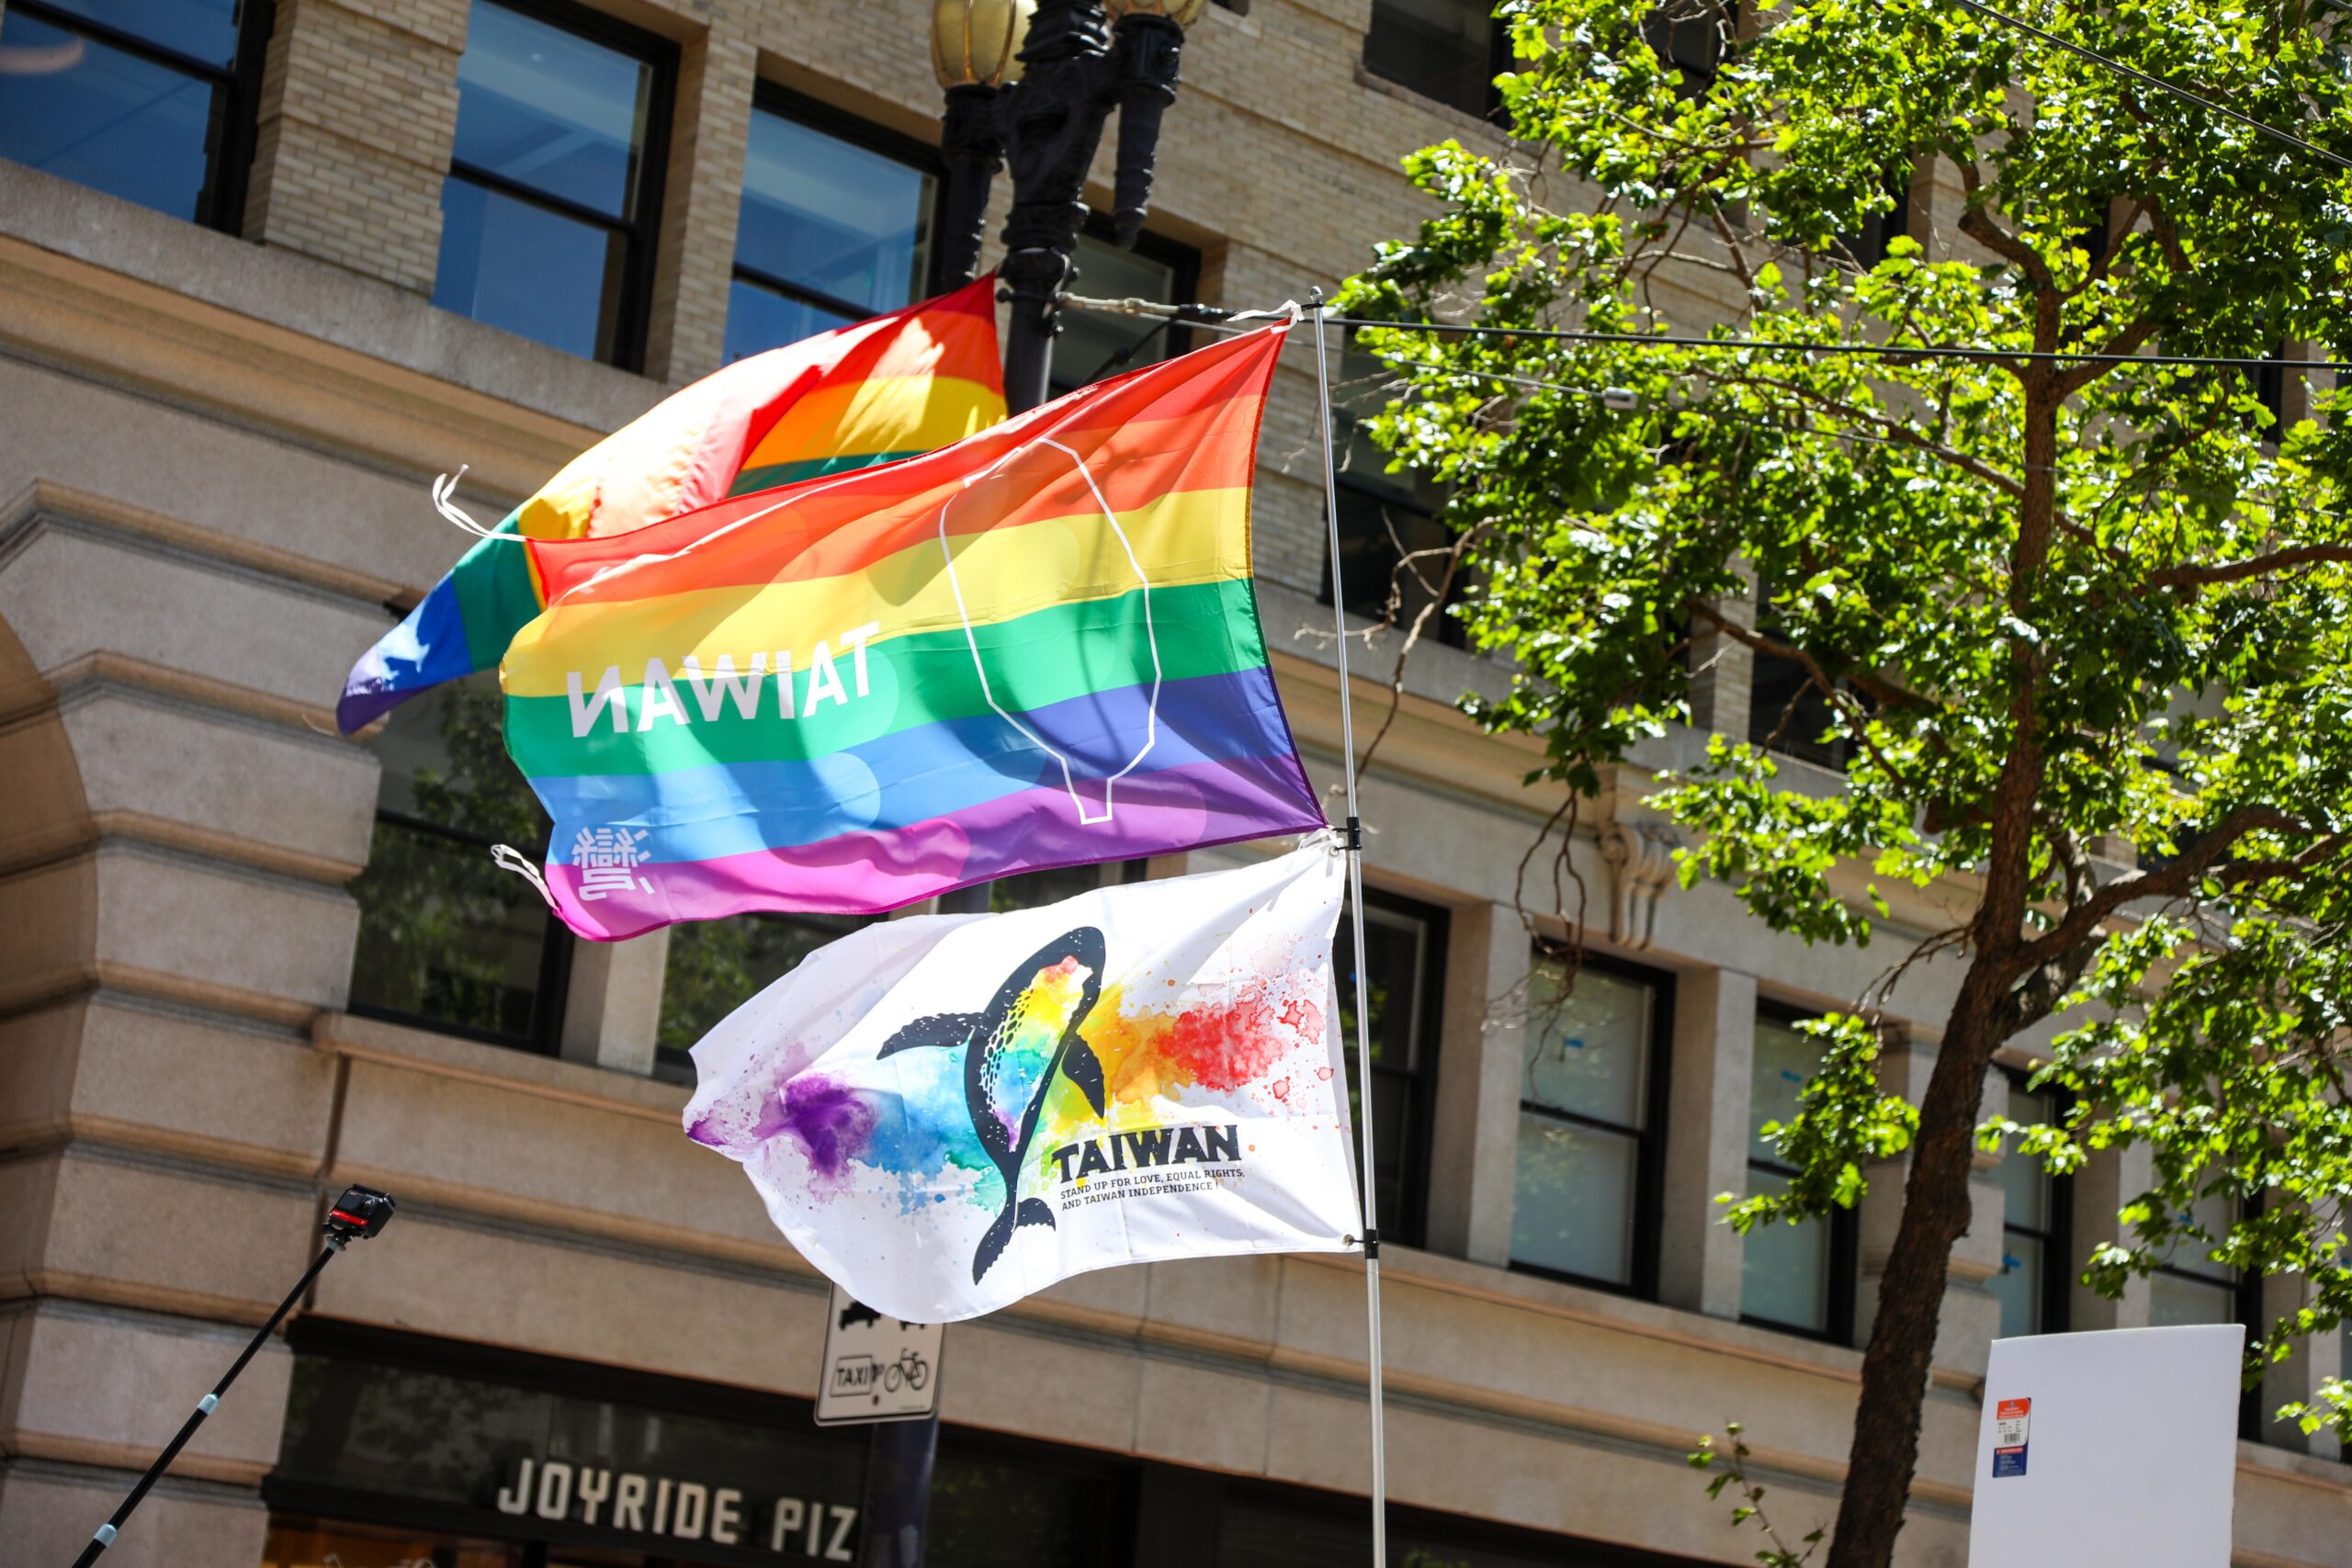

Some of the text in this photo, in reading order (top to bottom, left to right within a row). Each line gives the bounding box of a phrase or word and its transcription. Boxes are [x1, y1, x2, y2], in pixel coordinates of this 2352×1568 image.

[1051, 1124, 1241, 1183] TAIWAN
[1060, 1168, 1245, 1200] STAND UP FOR LOVE, EQUAL RIGHTS,
[1062, 1199, 1081, 1211] AND
[1083, 1191, 1125, 1205] TAIWAN
[1128, 1181, 1213, 1198] INDEPENDENCE
[836, 1366, 868, 1387] TAXI
[497, 1459, 743, 1544] JOYRIDE
